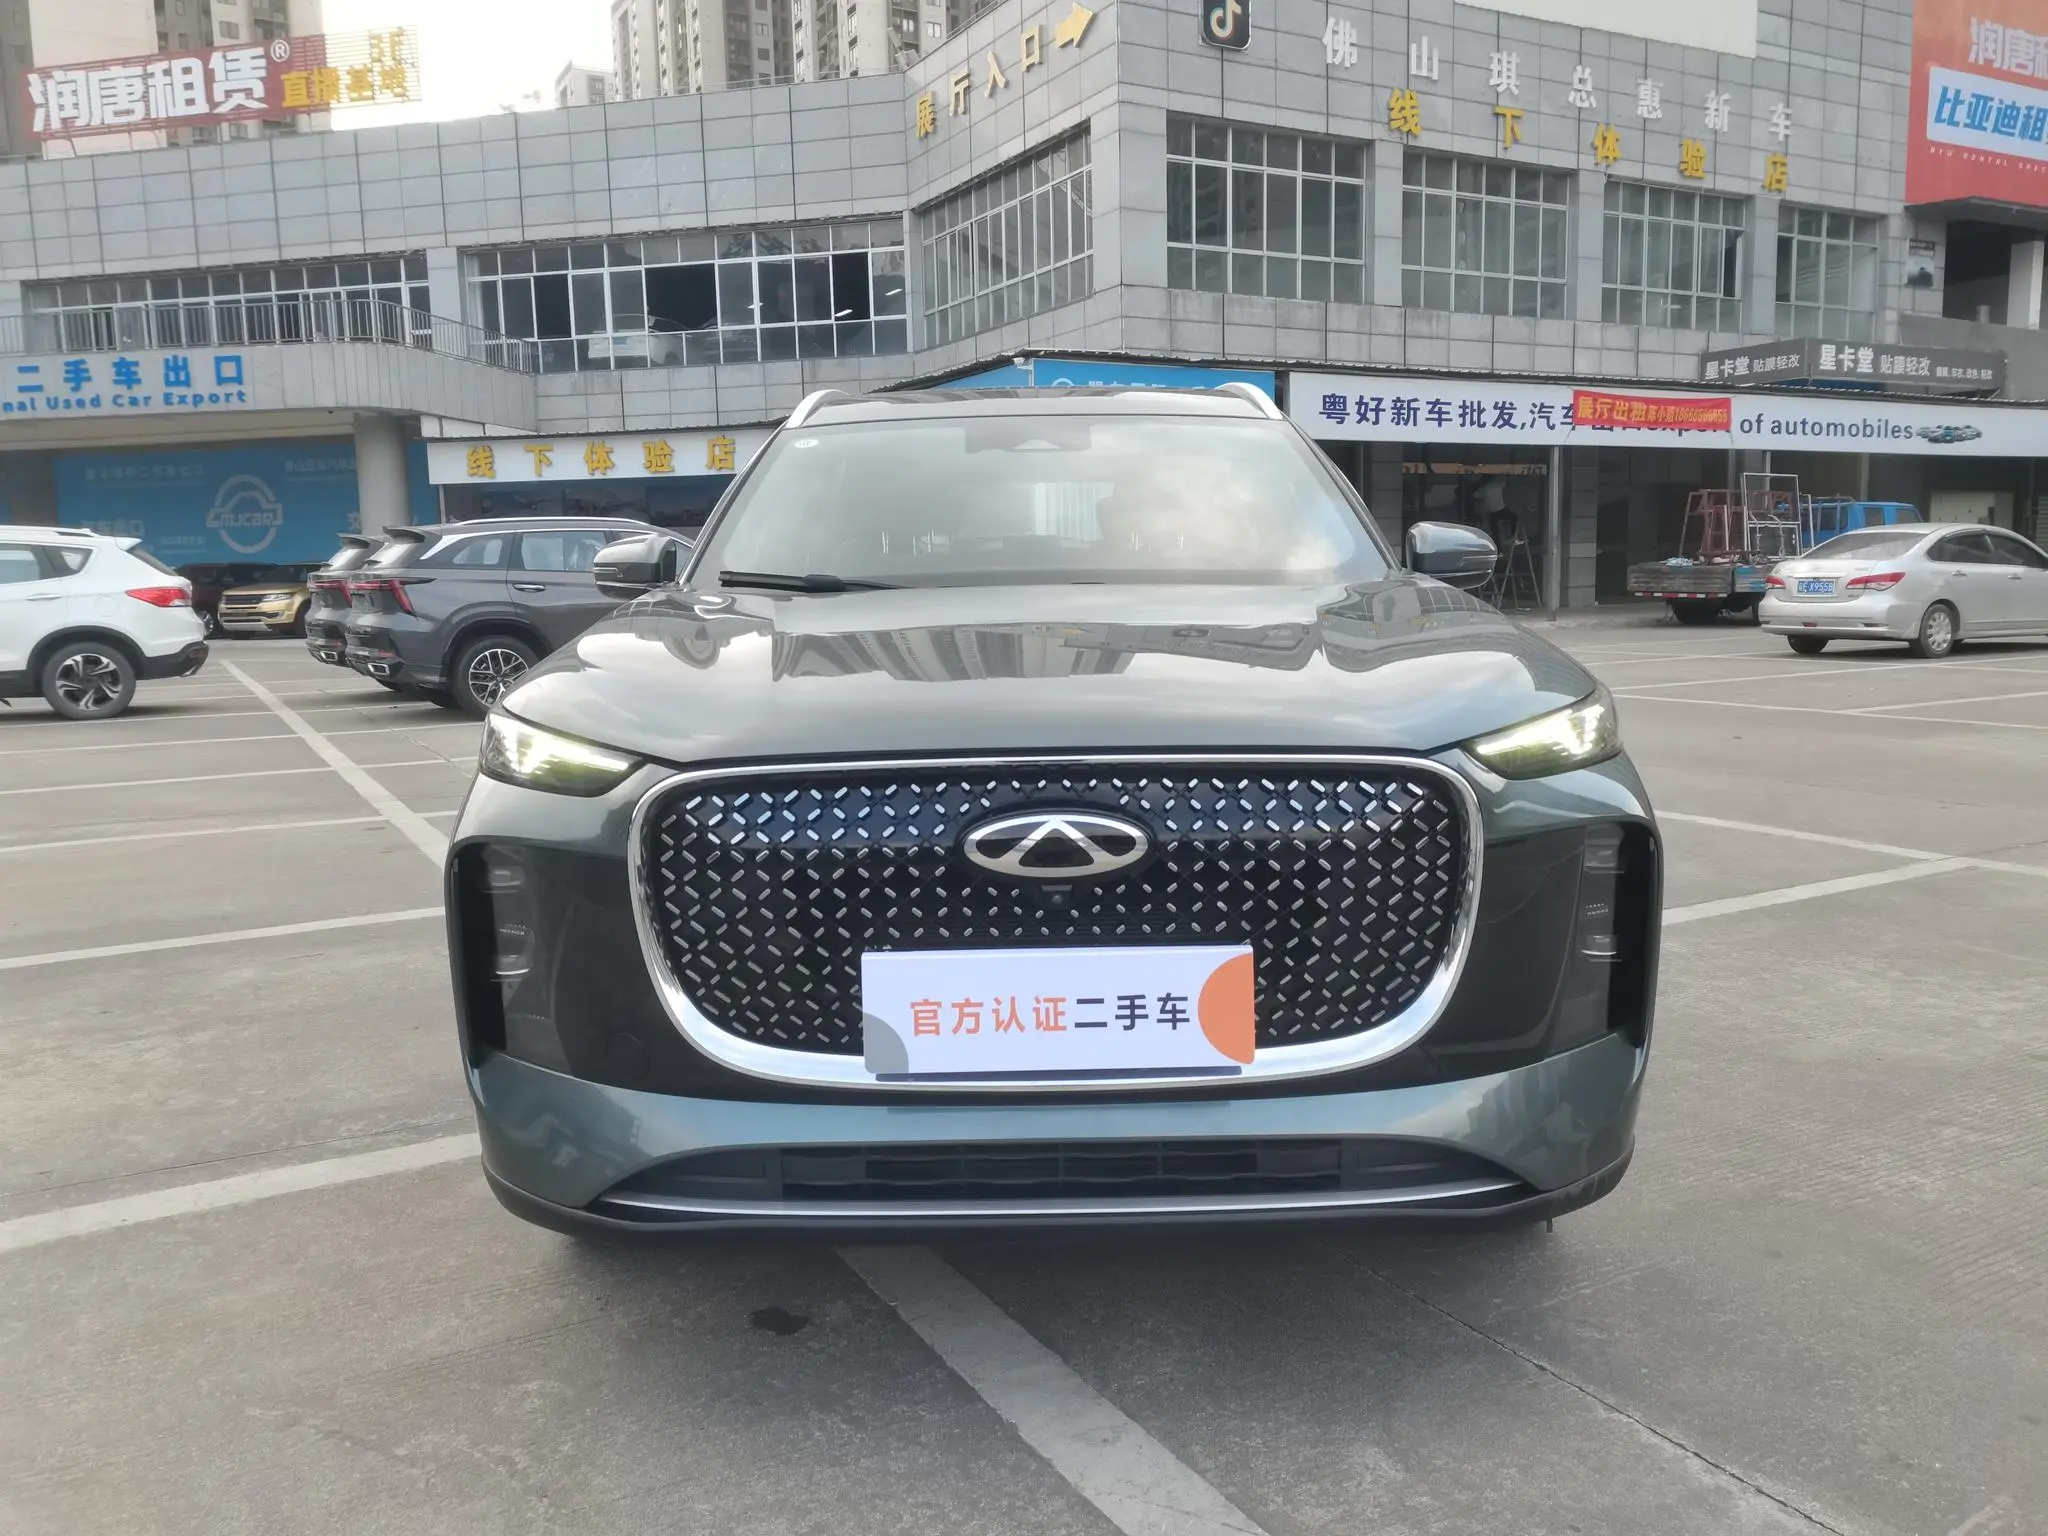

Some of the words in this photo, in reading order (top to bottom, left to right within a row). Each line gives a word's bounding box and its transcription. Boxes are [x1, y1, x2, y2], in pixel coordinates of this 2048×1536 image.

[28, 47, 268, 132] 润唐租赁
[916, 24, 1043, 139] 展厅入口
[1322, 17, 1792, 141] 佛山琪总惠新车
[1388, 88, 1789, 192] 线下体验店
[17, 355, 244, 390] 二手车出口
[1705, 356, 1749, 380] 星卡堂
[1819, 344, 1874, 373] 星卡堂
[46, 394, 101, 410] Used
[112, 394, 152, 407] Car
[163, 390, 247, 408] Export
[1740, 413, 1764, 434] of
[1771, 418, 1914, 439] automobiles
[466, 436, 737, 479] 线下体验店
[910, 992, 1190, 1036] 官方认证二手车
